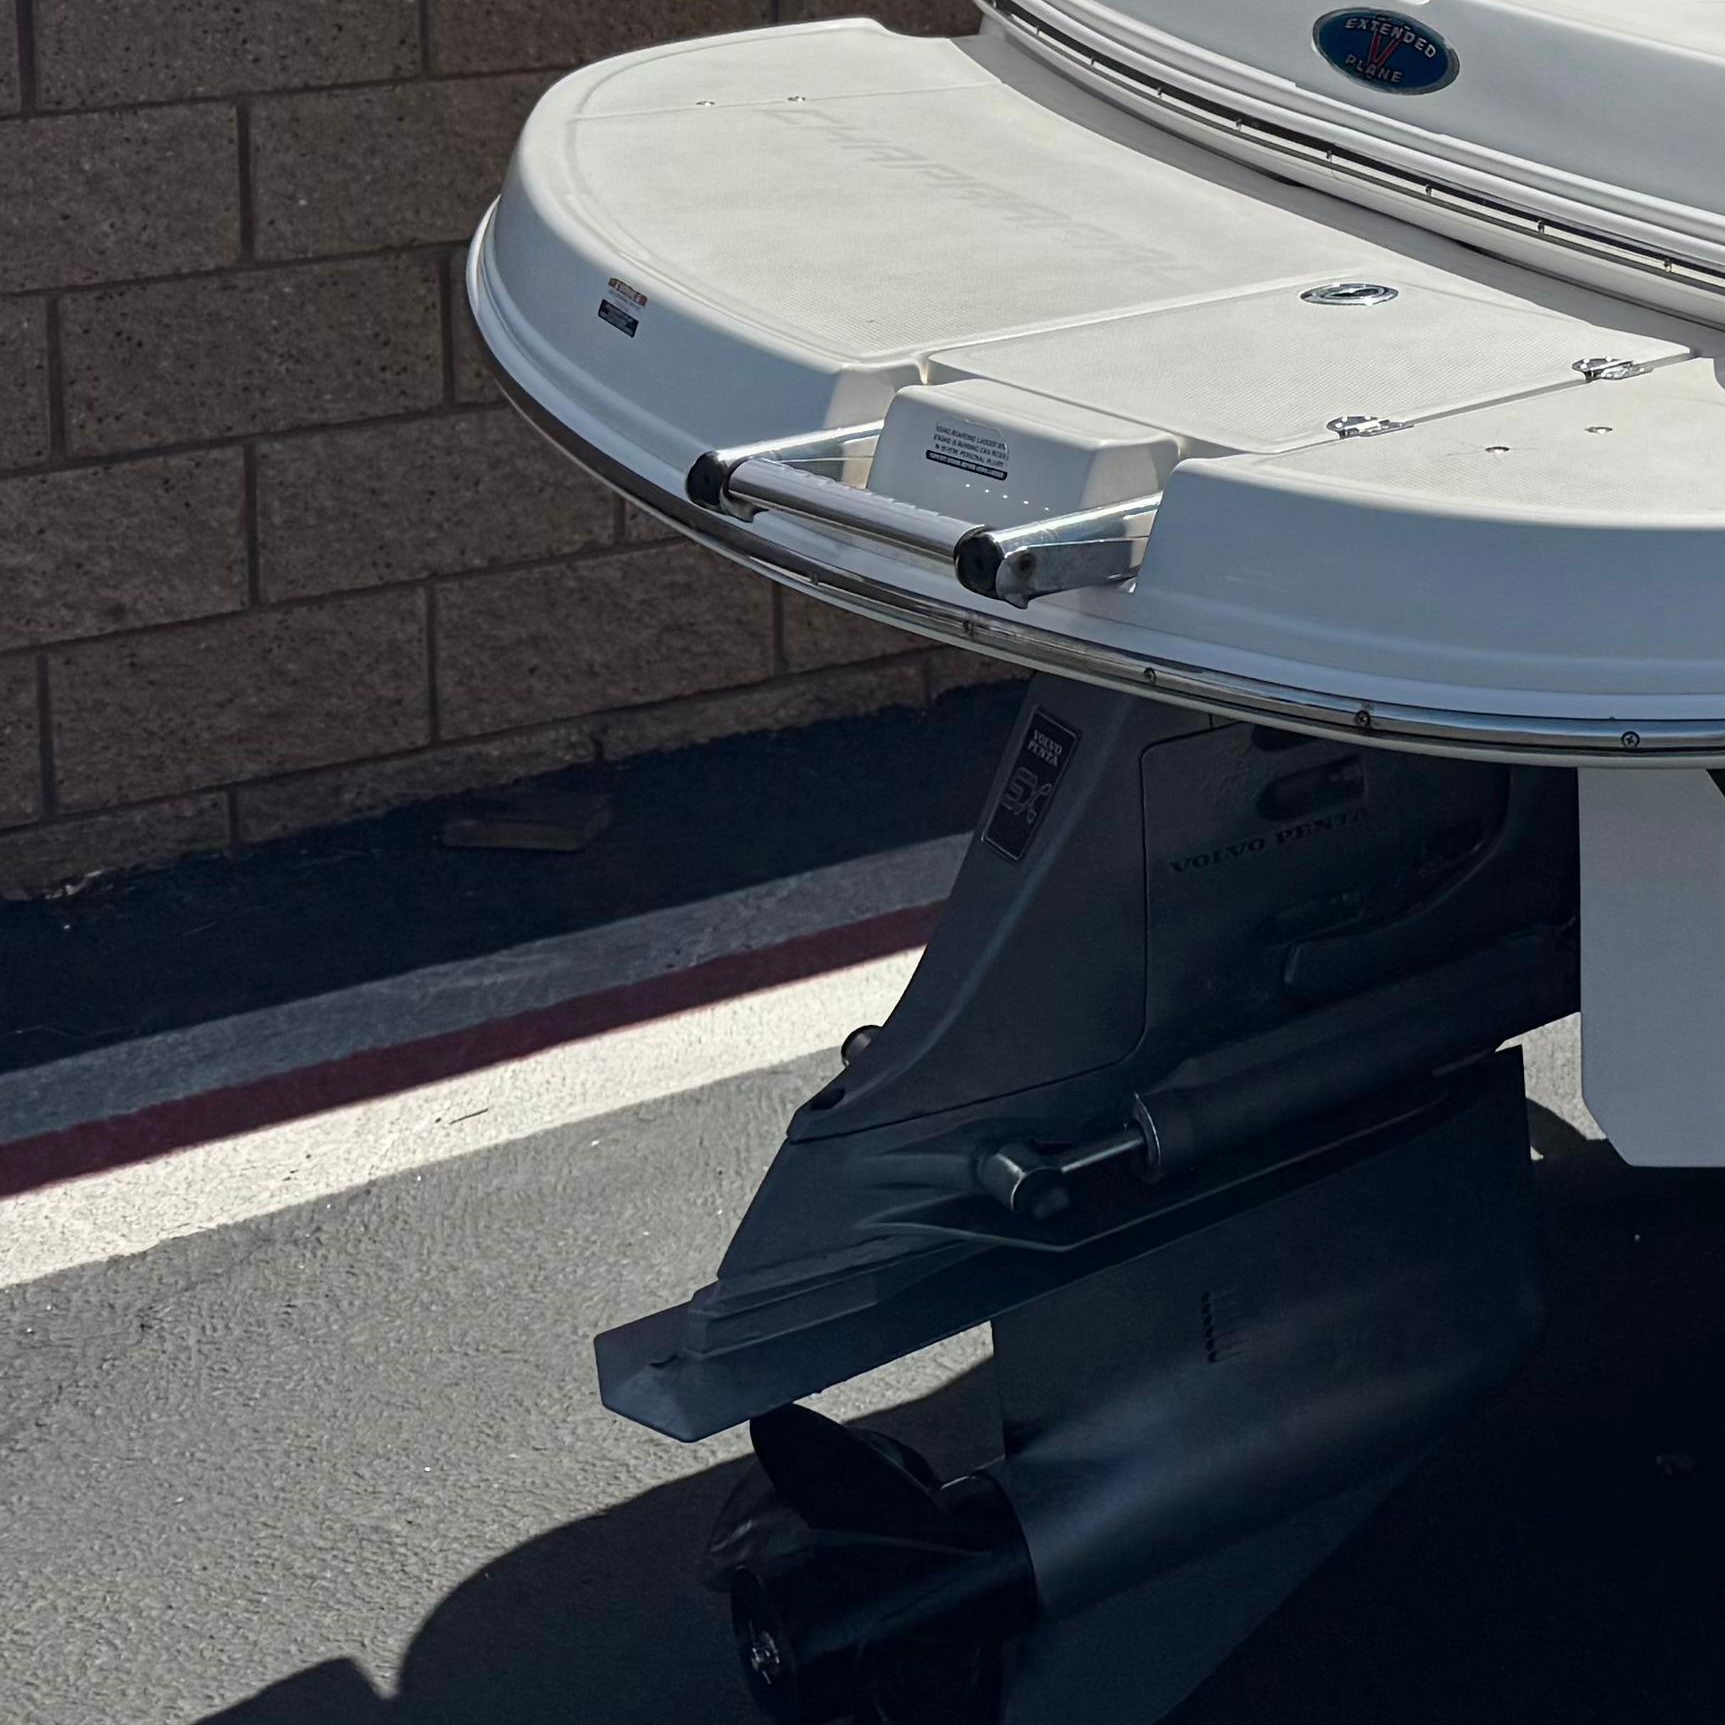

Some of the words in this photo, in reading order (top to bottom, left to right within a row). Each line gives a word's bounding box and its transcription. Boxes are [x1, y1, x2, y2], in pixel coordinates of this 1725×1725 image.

[1344, 17, 1437, 59] EXTENDED
[1344, 53, 1403, 84] PLANE
[1027, 739, 1059, 768] PENTA
[1033, 729, 1063, 756] VOLVO
[1169, 837, 1266, 873] VOLVO
[1275, 805, 1368, 845] PENTA
